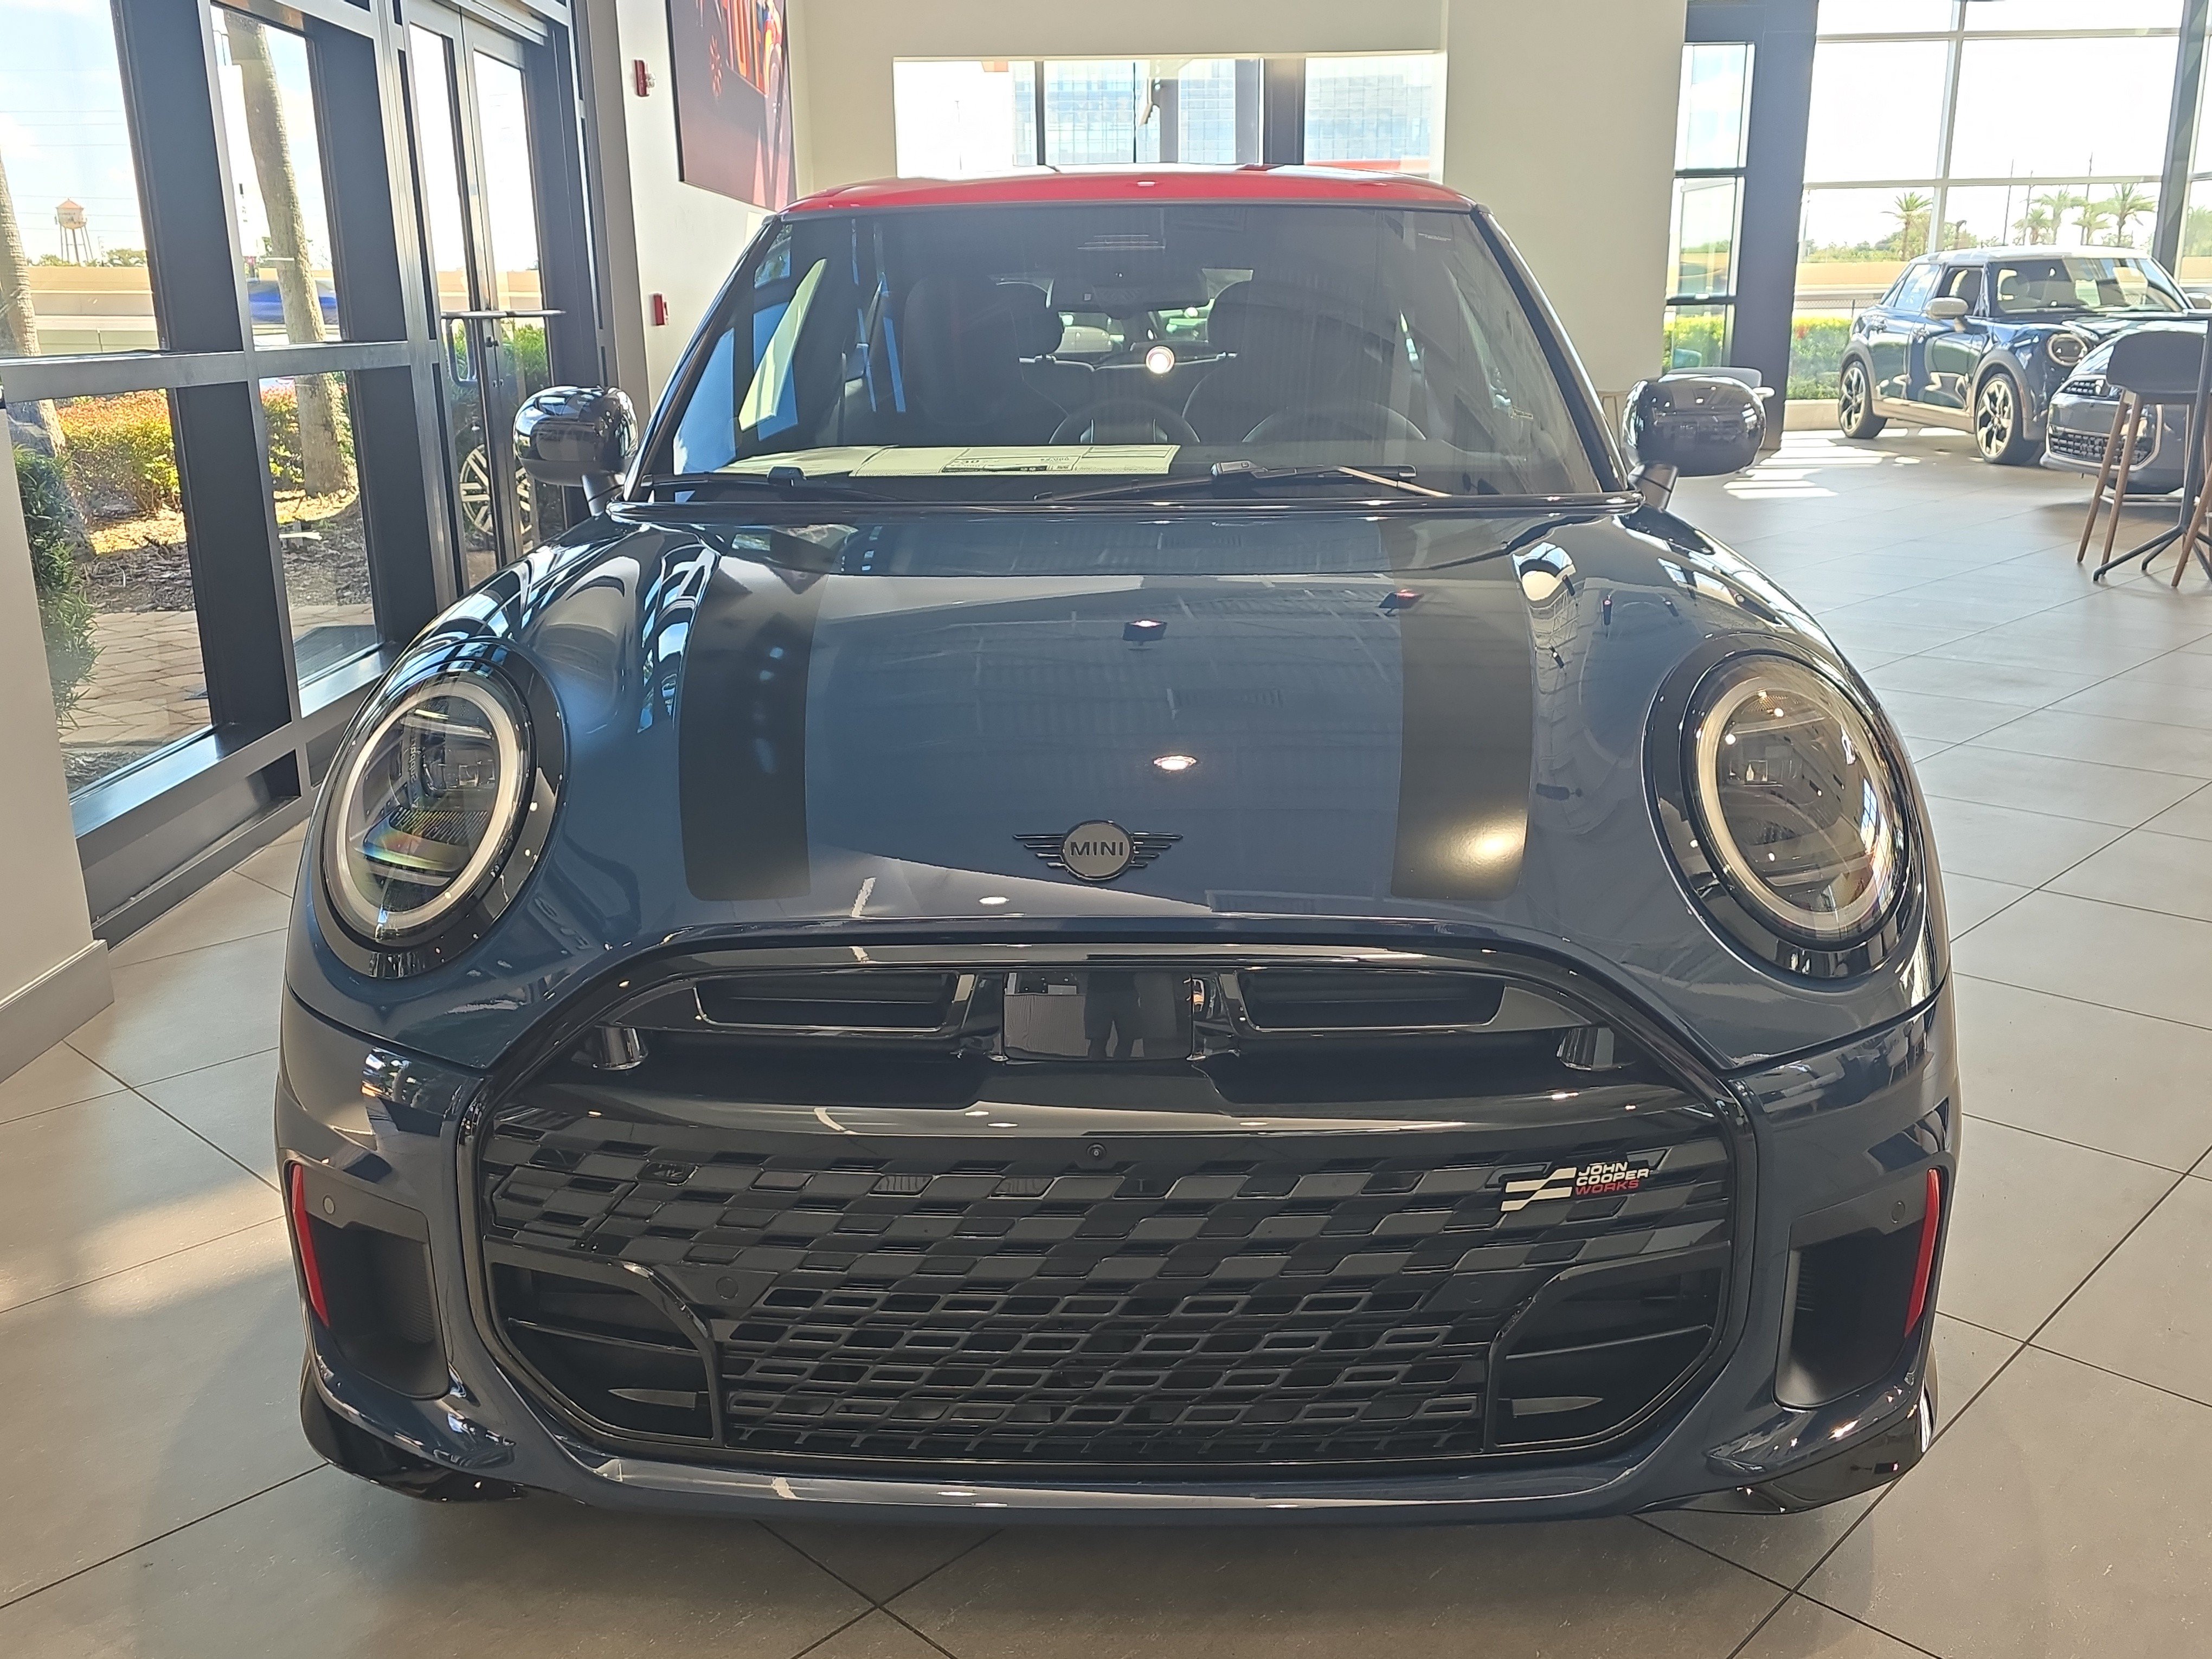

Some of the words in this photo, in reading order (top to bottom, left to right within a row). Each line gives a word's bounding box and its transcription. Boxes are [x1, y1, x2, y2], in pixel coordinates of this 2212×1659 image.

[1070, 841, 1124, 856] MINI
[1578, 1161, 1628, 1176] JOHN
[1576, 1168, 1649, 1186] COOPER
[1576, 1179, 1639, 1195] WORKS
